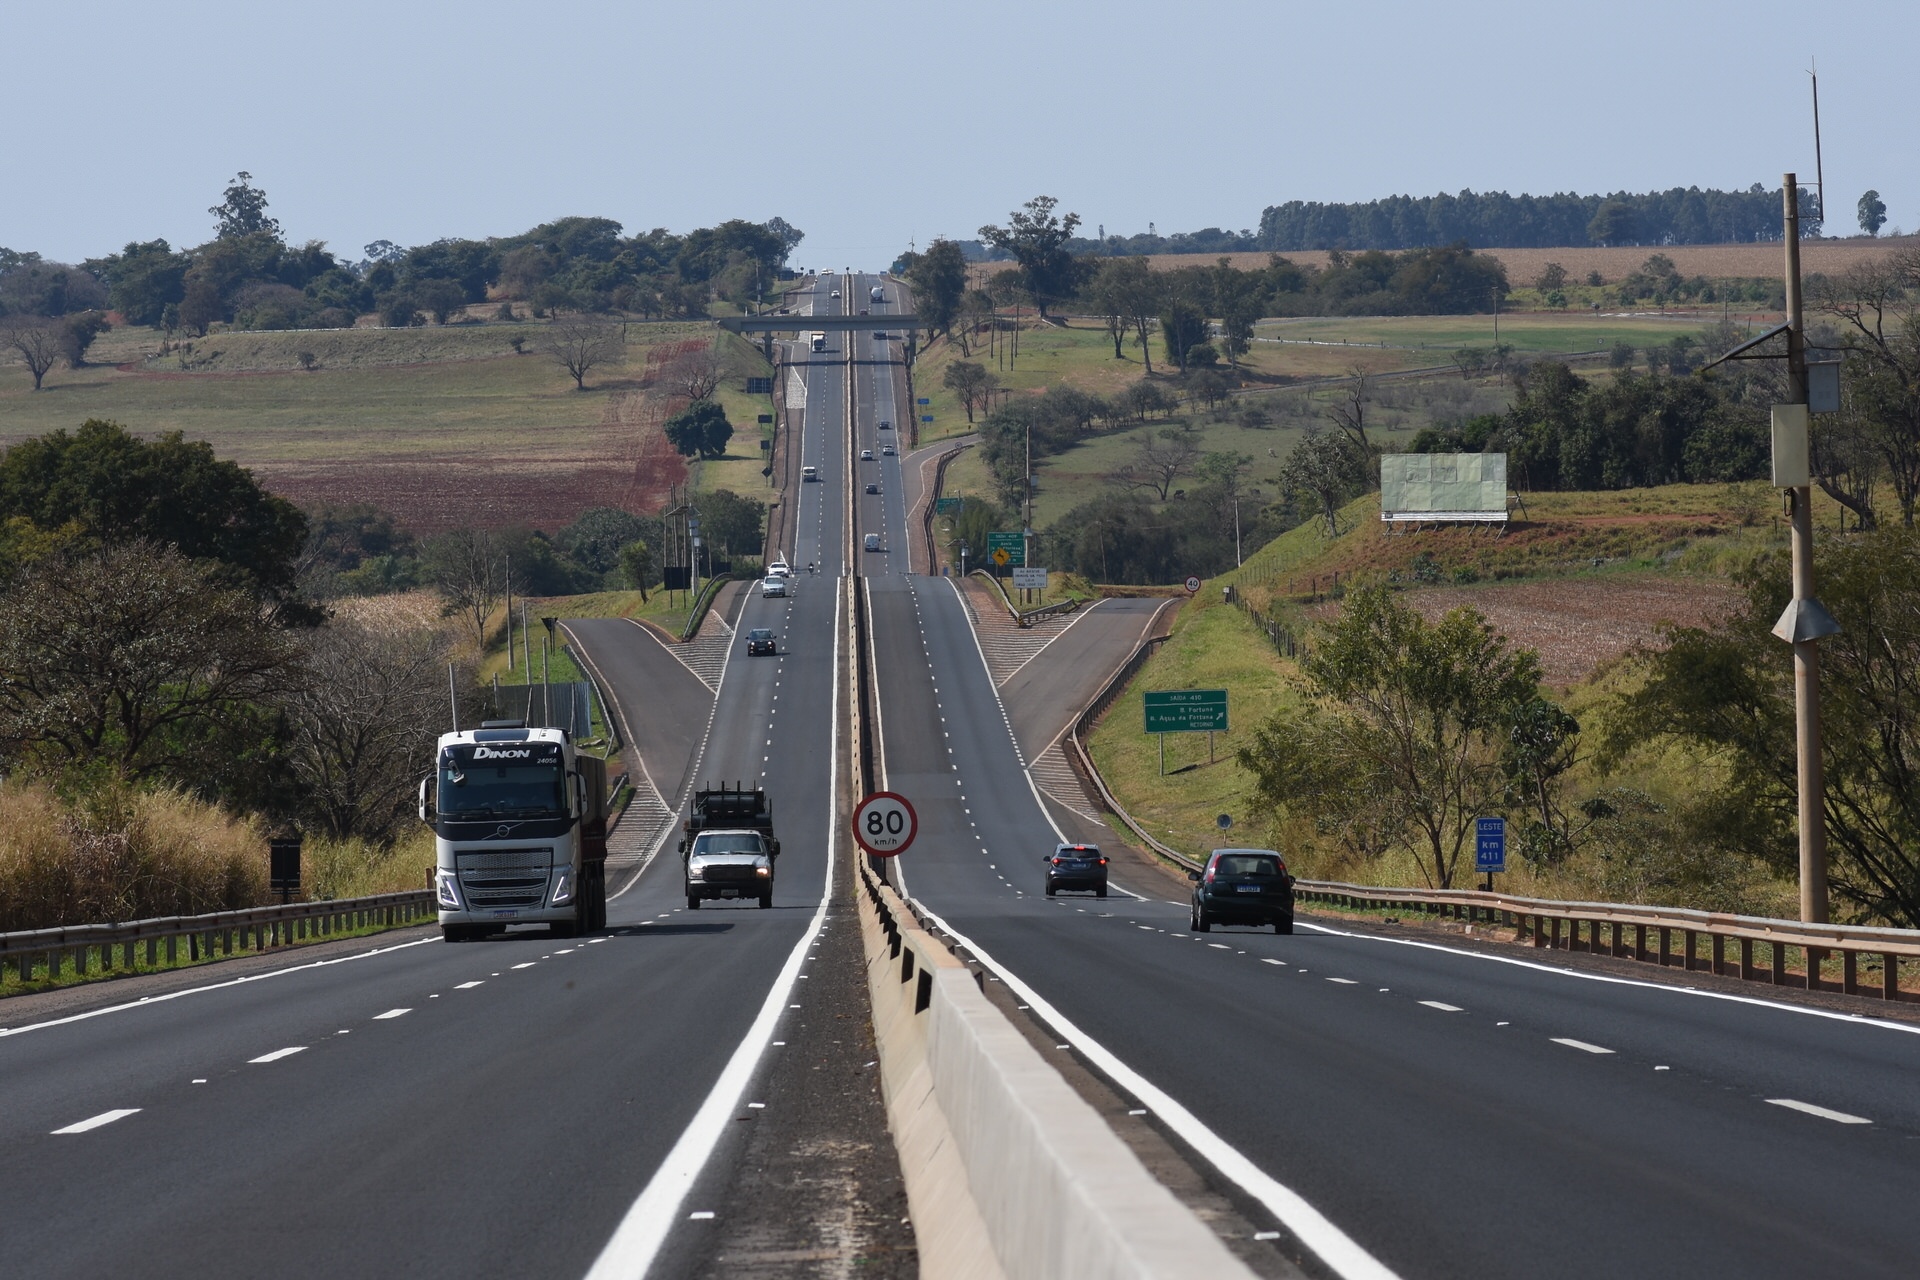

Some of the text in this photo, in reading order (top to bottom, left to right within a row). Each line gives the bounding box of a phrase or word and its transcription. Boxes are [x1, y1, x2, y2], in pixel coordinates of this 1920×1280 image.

[473, 747, 530, 760] DINON
[867, 810, 904, 835] 80
[1481, 852, 1498, 861] 411
